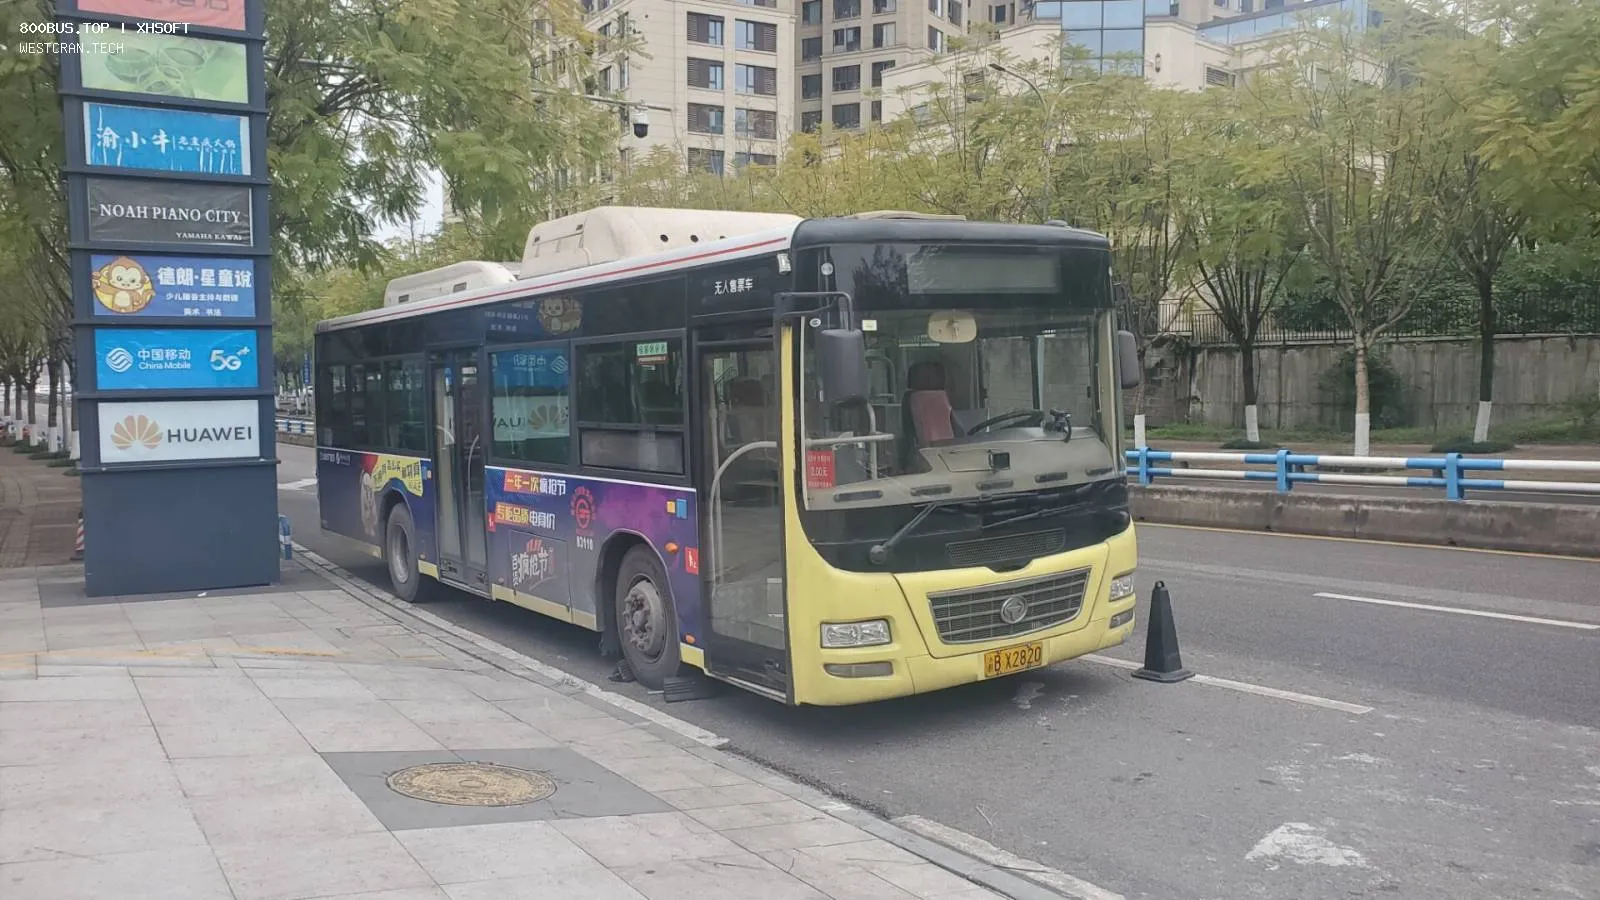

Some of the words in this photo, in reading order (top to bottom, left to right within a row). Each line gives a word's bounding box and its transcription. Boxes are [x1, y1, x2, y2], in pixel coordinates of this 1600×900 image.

[100, 203, 148, 219] NOAH
[153, 206, 201, 221] PIANO
[205, 209, 241, 224] CITY
[176, 232, 212, 240] YAMAHA
[214, 233, 242, 241] KAWAI
[714, 277, 753, 295] 无人售票车
[137, 348, 191, 361] 中国移动
[138, 362, 164, 370] China
[164, 361, 191, 370] Mobile
[167, 426, 252, 443] HUAWEI
